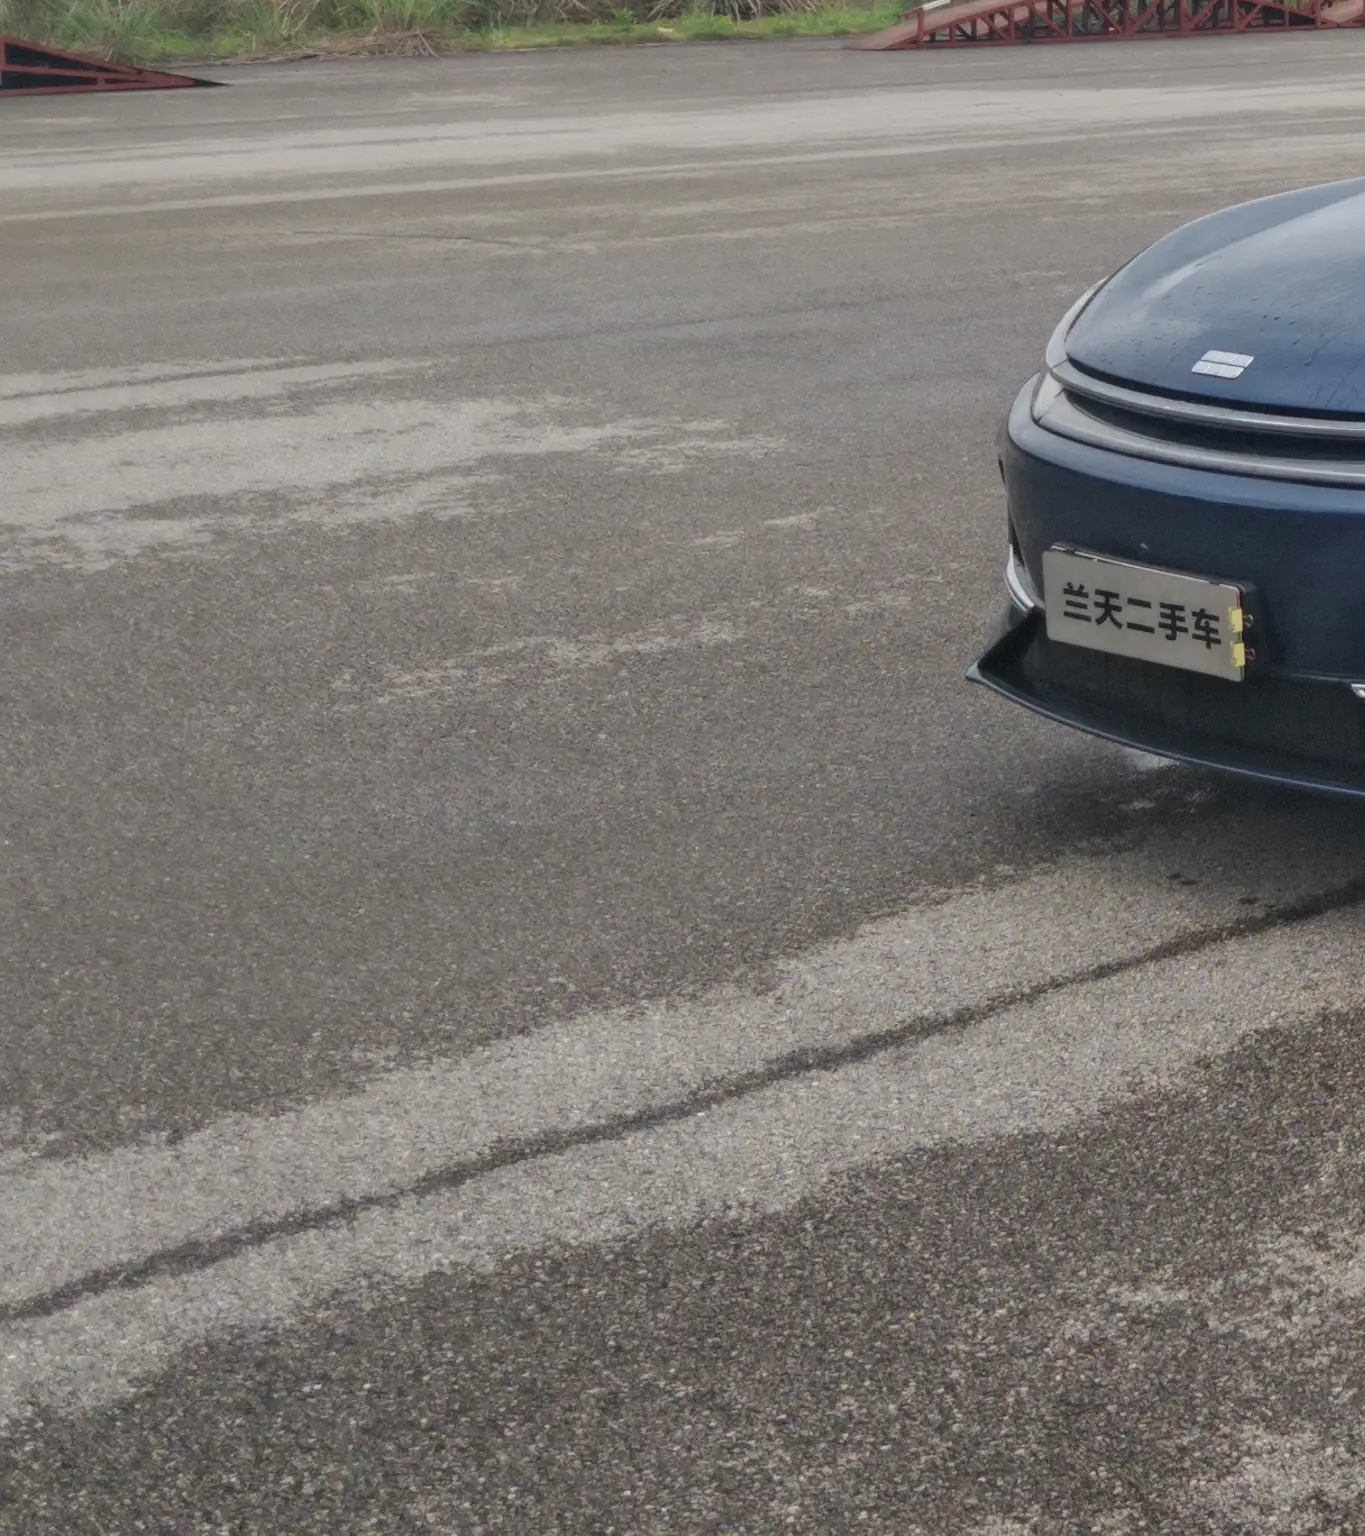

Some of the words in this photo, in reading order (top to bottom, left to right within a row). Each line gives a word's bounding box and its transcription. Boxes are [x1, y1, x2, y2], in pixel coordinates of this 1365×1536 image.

[1063, 582, 1222, 650] 兰天二手车
